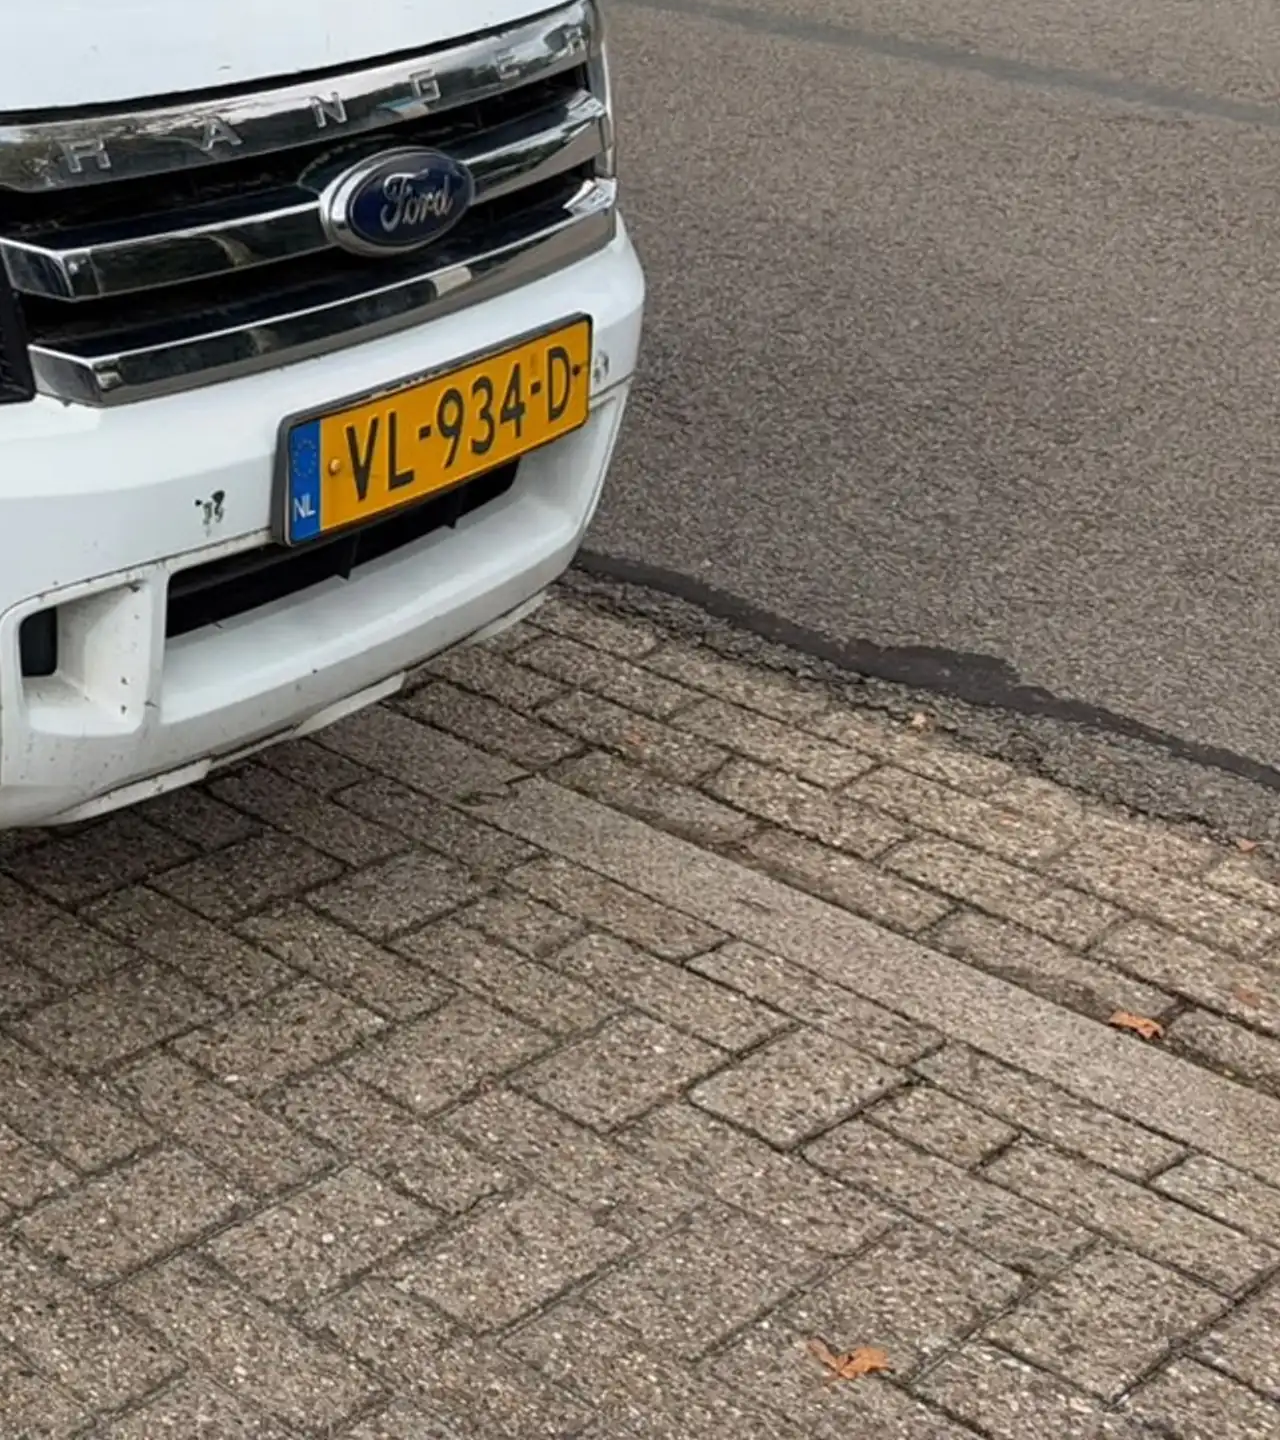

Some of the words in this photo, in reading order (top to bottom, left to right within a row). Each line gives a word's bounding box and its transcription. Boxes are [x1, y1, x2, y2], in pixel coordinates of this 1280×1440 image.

[64, 26, 587, 174] RANGER
[379, 168, 454, 231] Ford
[345, 345, 572, 502] VL-934-D
[292, 492, 316, 524] NL
